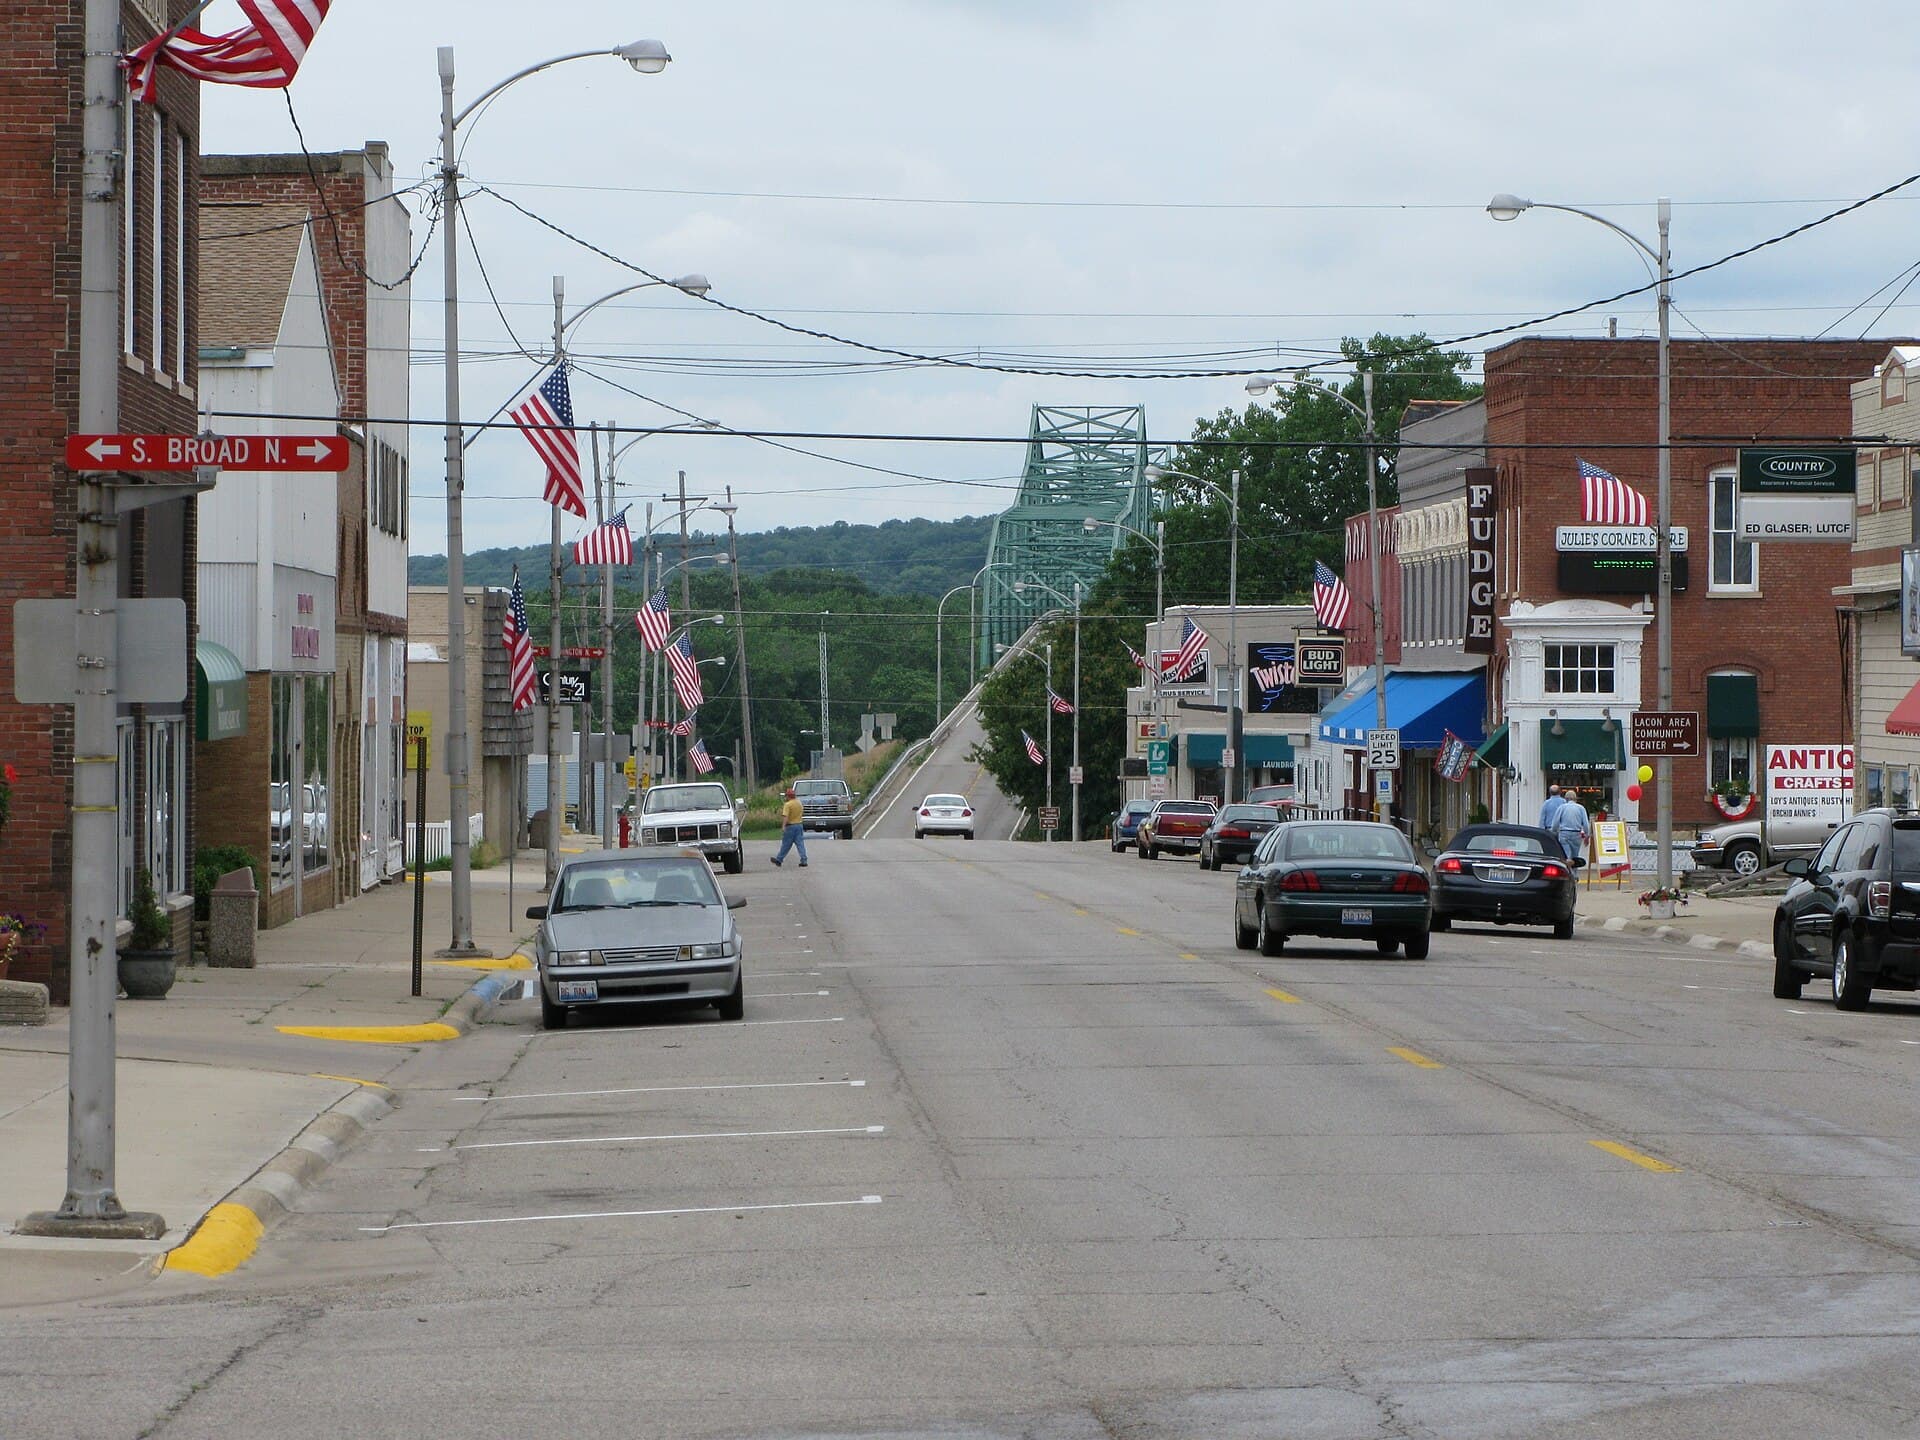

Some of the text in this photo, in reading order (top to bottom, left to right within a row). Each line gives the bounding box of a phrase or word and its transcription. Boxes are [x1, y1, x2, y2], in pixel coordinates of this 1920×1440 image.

[131, 437, 287, 464] S. BROAD N.
[1770, 460, 1825, 471] COUNTRY
[1745, 524, 1760, 533] ED
[1816, 523, 1851, 533] LUTCF
[1560, 532, 1685, 546] JULIE'S CORNER SRE
[1470, 484, 1494, 638] FUDGE
[1308, 650, 1335, 660] BUD
[1302, 660, 1340, 670] LIGHT
[1634, 718, 1691, 727] LACON AREA
[1370, 733, 1396, 741] SPEED
[1634, 729, 1684, 738] COMMUNITY
[1372, 741, 1393, 749] LIMIT
[1634, 740, 1667, 750] CENTER
[1371, 750, 1397, 764] 25
[1788, 796, 1818, 806] ANTIQUES
[1772, 809, 1793, 817] ORCHID
